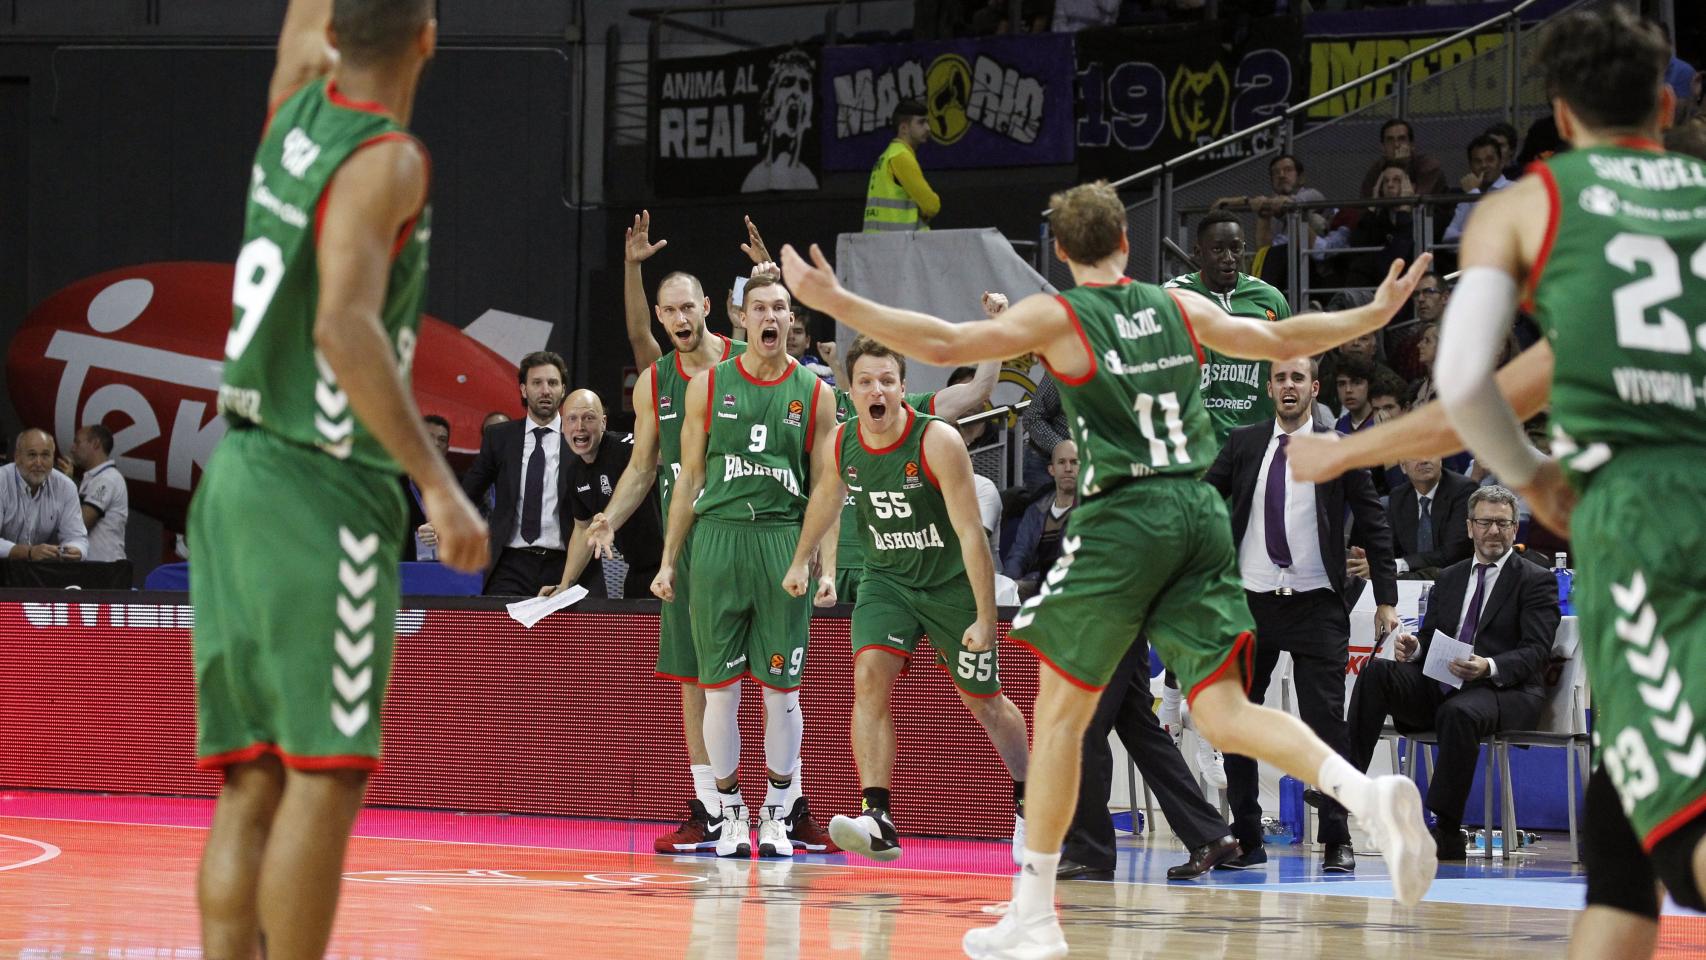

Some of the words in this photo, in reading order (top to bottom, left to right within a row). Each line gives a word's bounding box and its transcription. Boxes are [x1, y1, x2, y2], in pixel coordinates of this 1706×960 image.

[662, 70, 727, 100] ANIMA
[732, 64, 759, 95] AL
[659, 104, 758, 158] REAL
[225, 236, 285, 361] 9
[748, 424, 768, 453] 9
[1133, 391, 1192, 467] 11
[869, 491, 913, 519] 55
[788, 647, 804, 676] 9
[957, 650, 993, 682] 55
